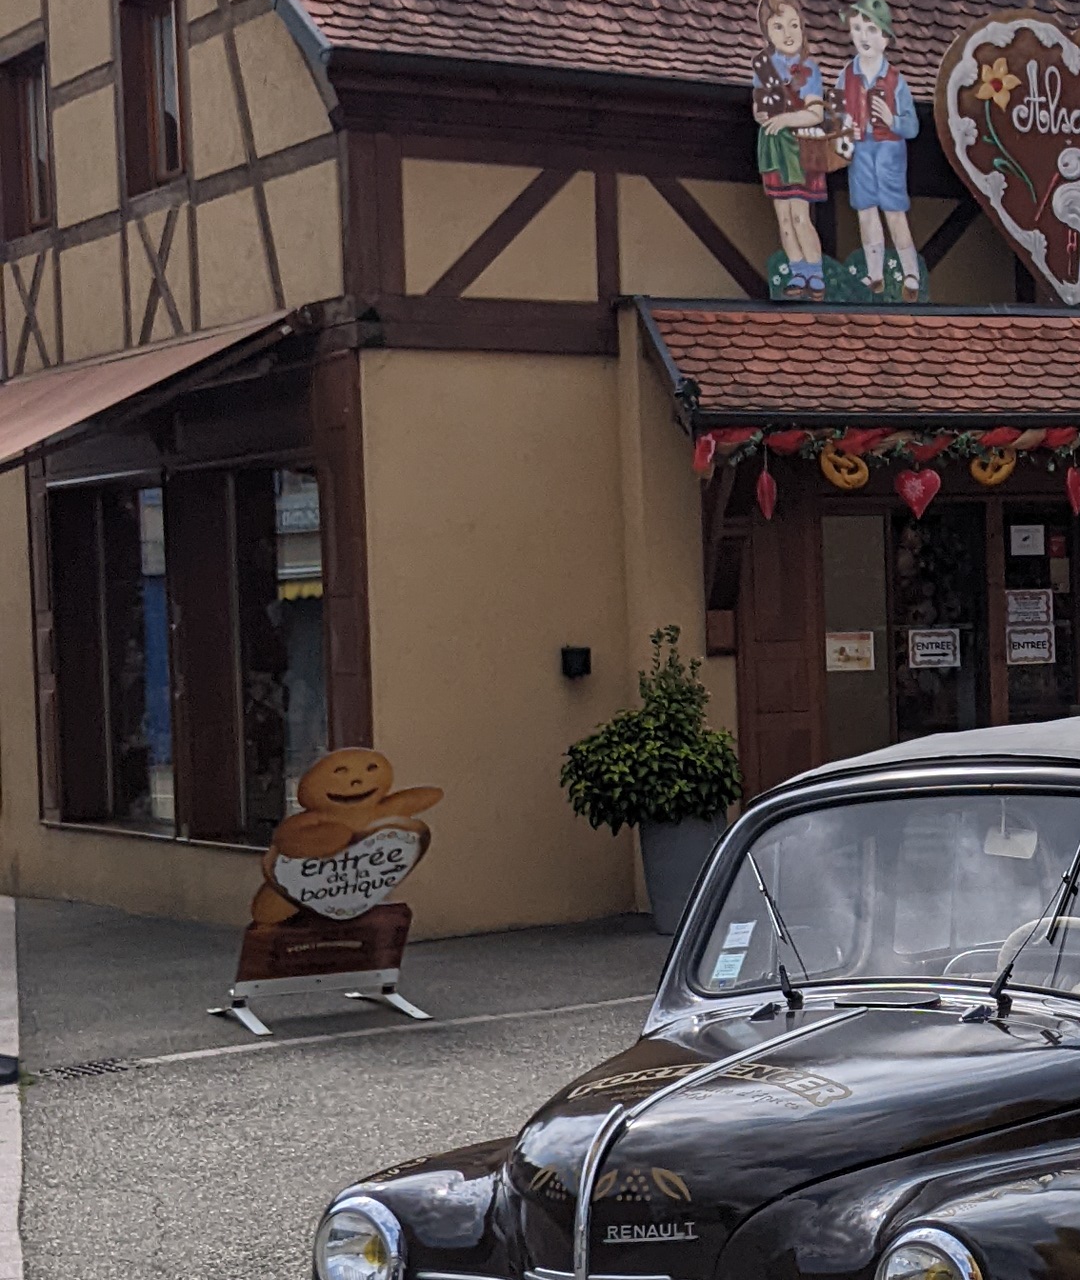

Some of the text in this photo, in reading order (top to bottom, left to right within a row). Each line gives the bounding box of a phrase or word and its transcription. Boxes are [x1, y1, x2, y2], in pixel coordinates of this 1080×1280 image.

[301, 846, 403, 877] Entrée
[327, 869, 370, 884] de la
[301, 875, 397, 902] boutique
[607, 1222, 695, 1239] RENAULT
